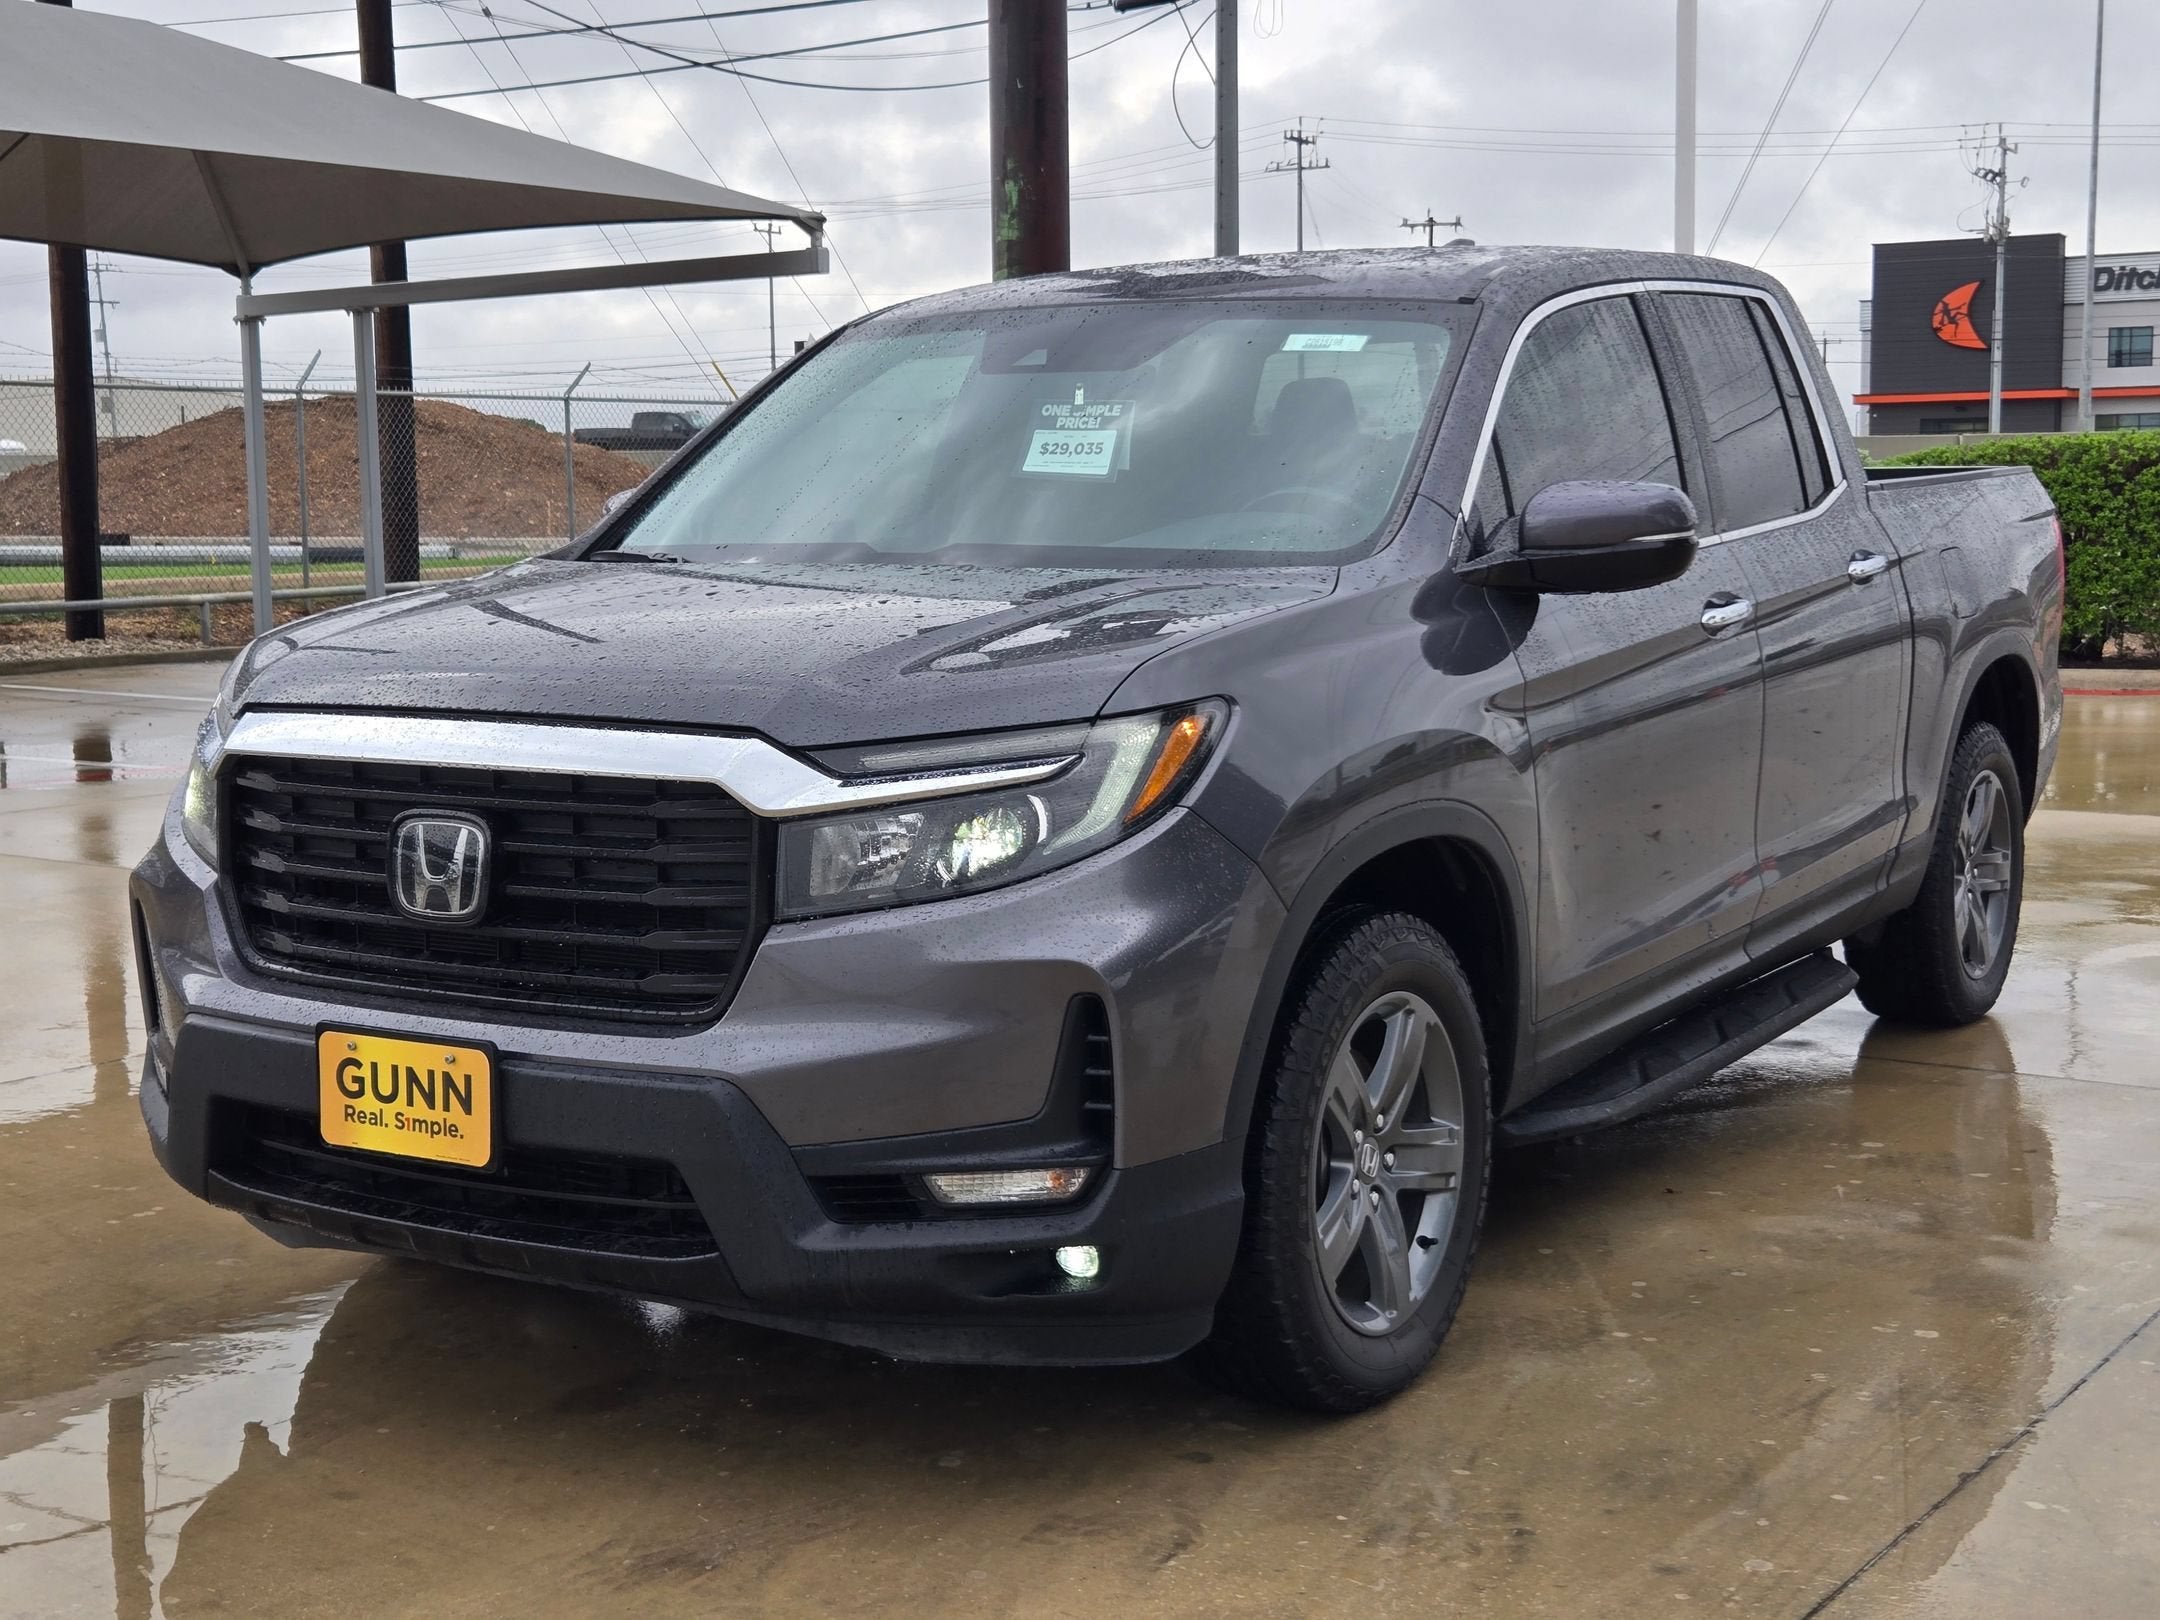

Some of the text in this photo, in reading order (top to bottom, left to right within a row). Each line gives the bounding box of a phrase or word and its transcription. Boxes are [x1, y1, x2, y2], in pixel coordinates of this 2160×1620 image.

[1041, 404, 1072, 416] ONE
[1056, 417, 1101, 429] PRICE!
[1040, 442, 1104, 457] $29,035
[336, 1057, 472, 1116] GUNN
[344, 1104, 389, 1128] Real.
